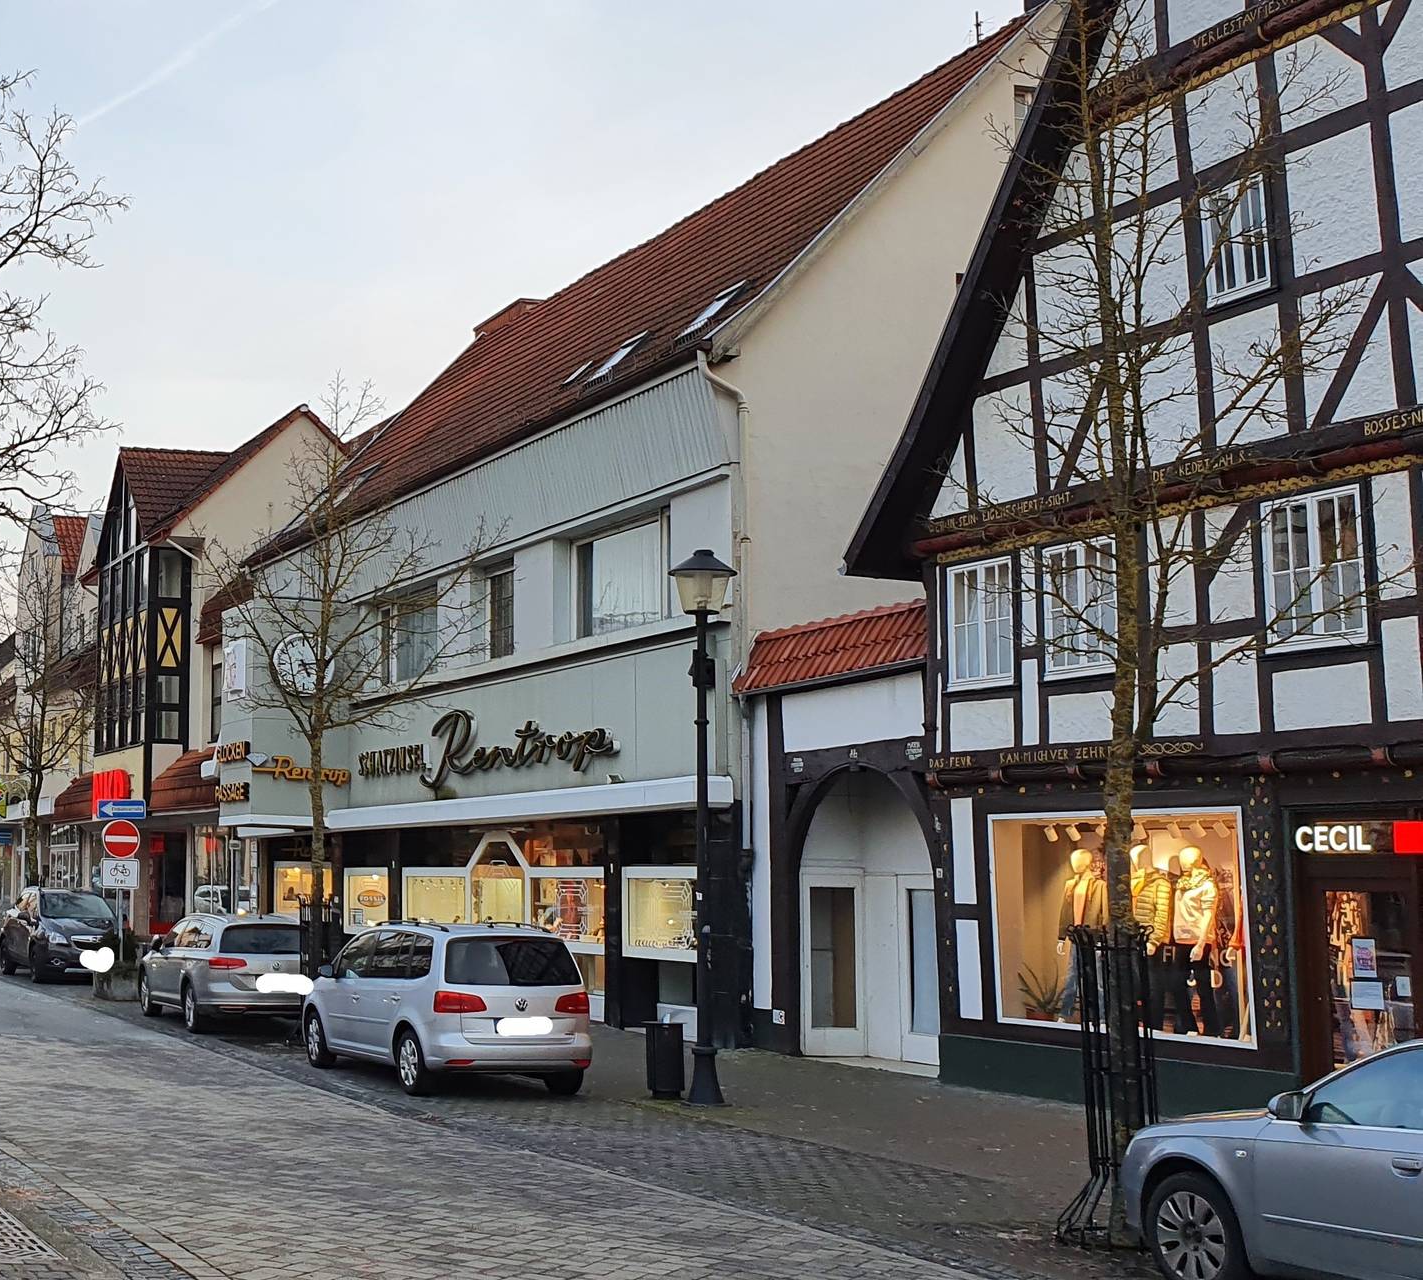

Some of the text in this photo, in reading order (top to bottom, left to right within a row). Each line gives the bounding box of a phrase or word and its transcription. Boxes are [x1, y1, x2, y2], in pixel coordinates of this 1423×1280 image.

[216, 741, 246, 763] GLOCKEN
[419, 709, 621, 788] Rentrop
[215, 782, 246, 803] PASSAGE
[1295, 825, 1373, 852] CECIL
[114, 877, 126, 885] frei
